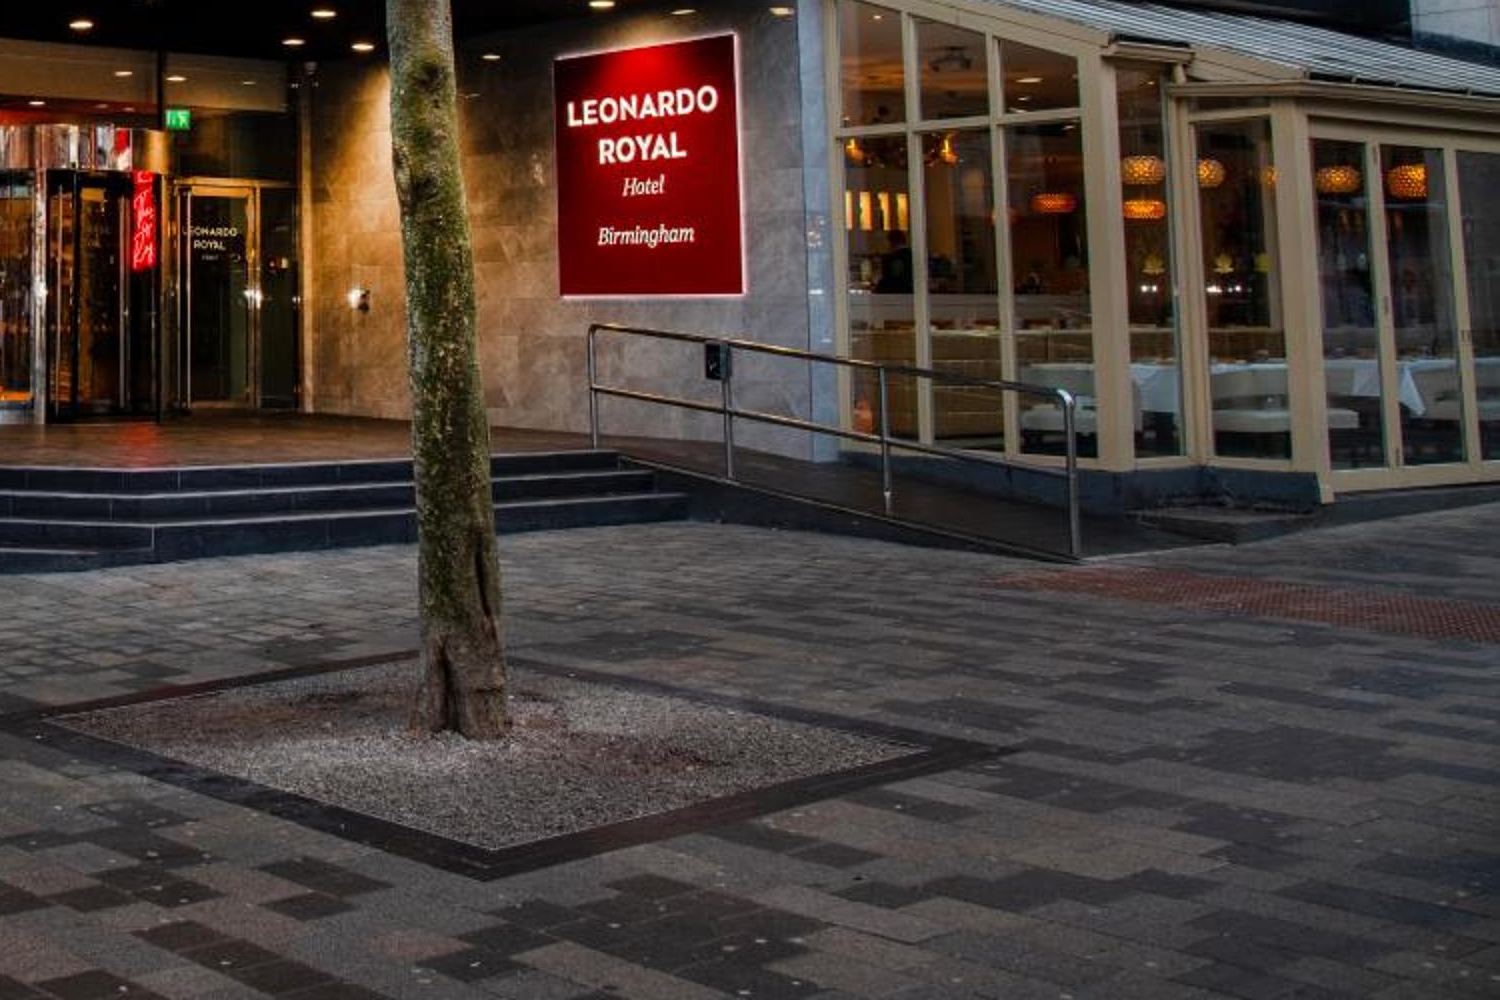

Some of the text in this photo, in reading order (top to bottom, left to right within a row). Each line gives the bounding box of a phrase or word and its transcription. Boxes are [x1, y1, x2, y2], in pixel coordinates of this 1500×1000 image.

[567, 85, 718, 127] LEONARDO
[598, 132, 687, 165] ROYAL
[623, 174, 664, 197] Hotel
[598, 223, 694, 248] Birmingham
